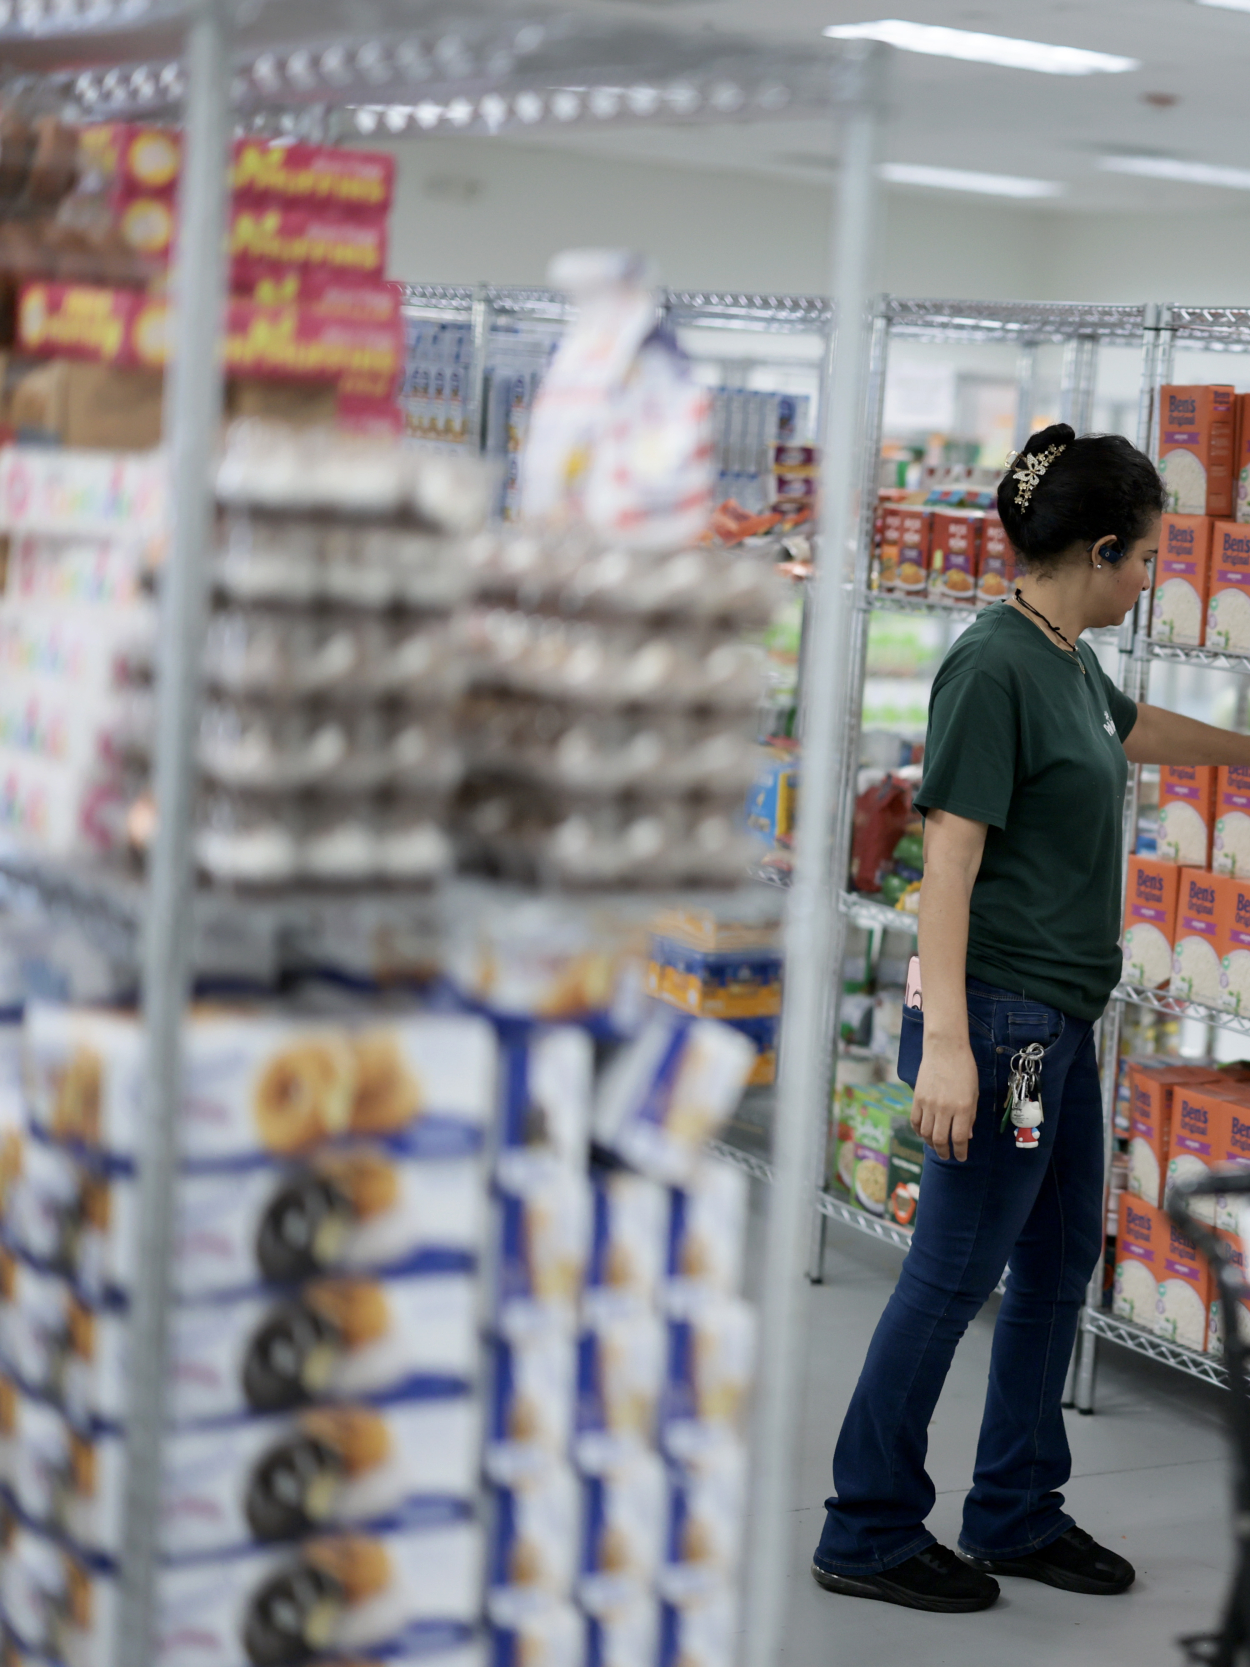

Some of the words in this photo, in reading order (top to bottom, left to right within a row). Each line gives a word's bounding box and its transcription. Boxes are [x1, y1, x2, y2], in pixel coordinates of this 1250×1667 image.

[1169, 395, 1196, 412] Ben's
[1169, 524, 1194, 543] Ben's
[1223, 533, 1250, 553] Ben's
[1137, 869, 1163, 891] Ben's
[1189, 881, 1215, 903] Ben's
